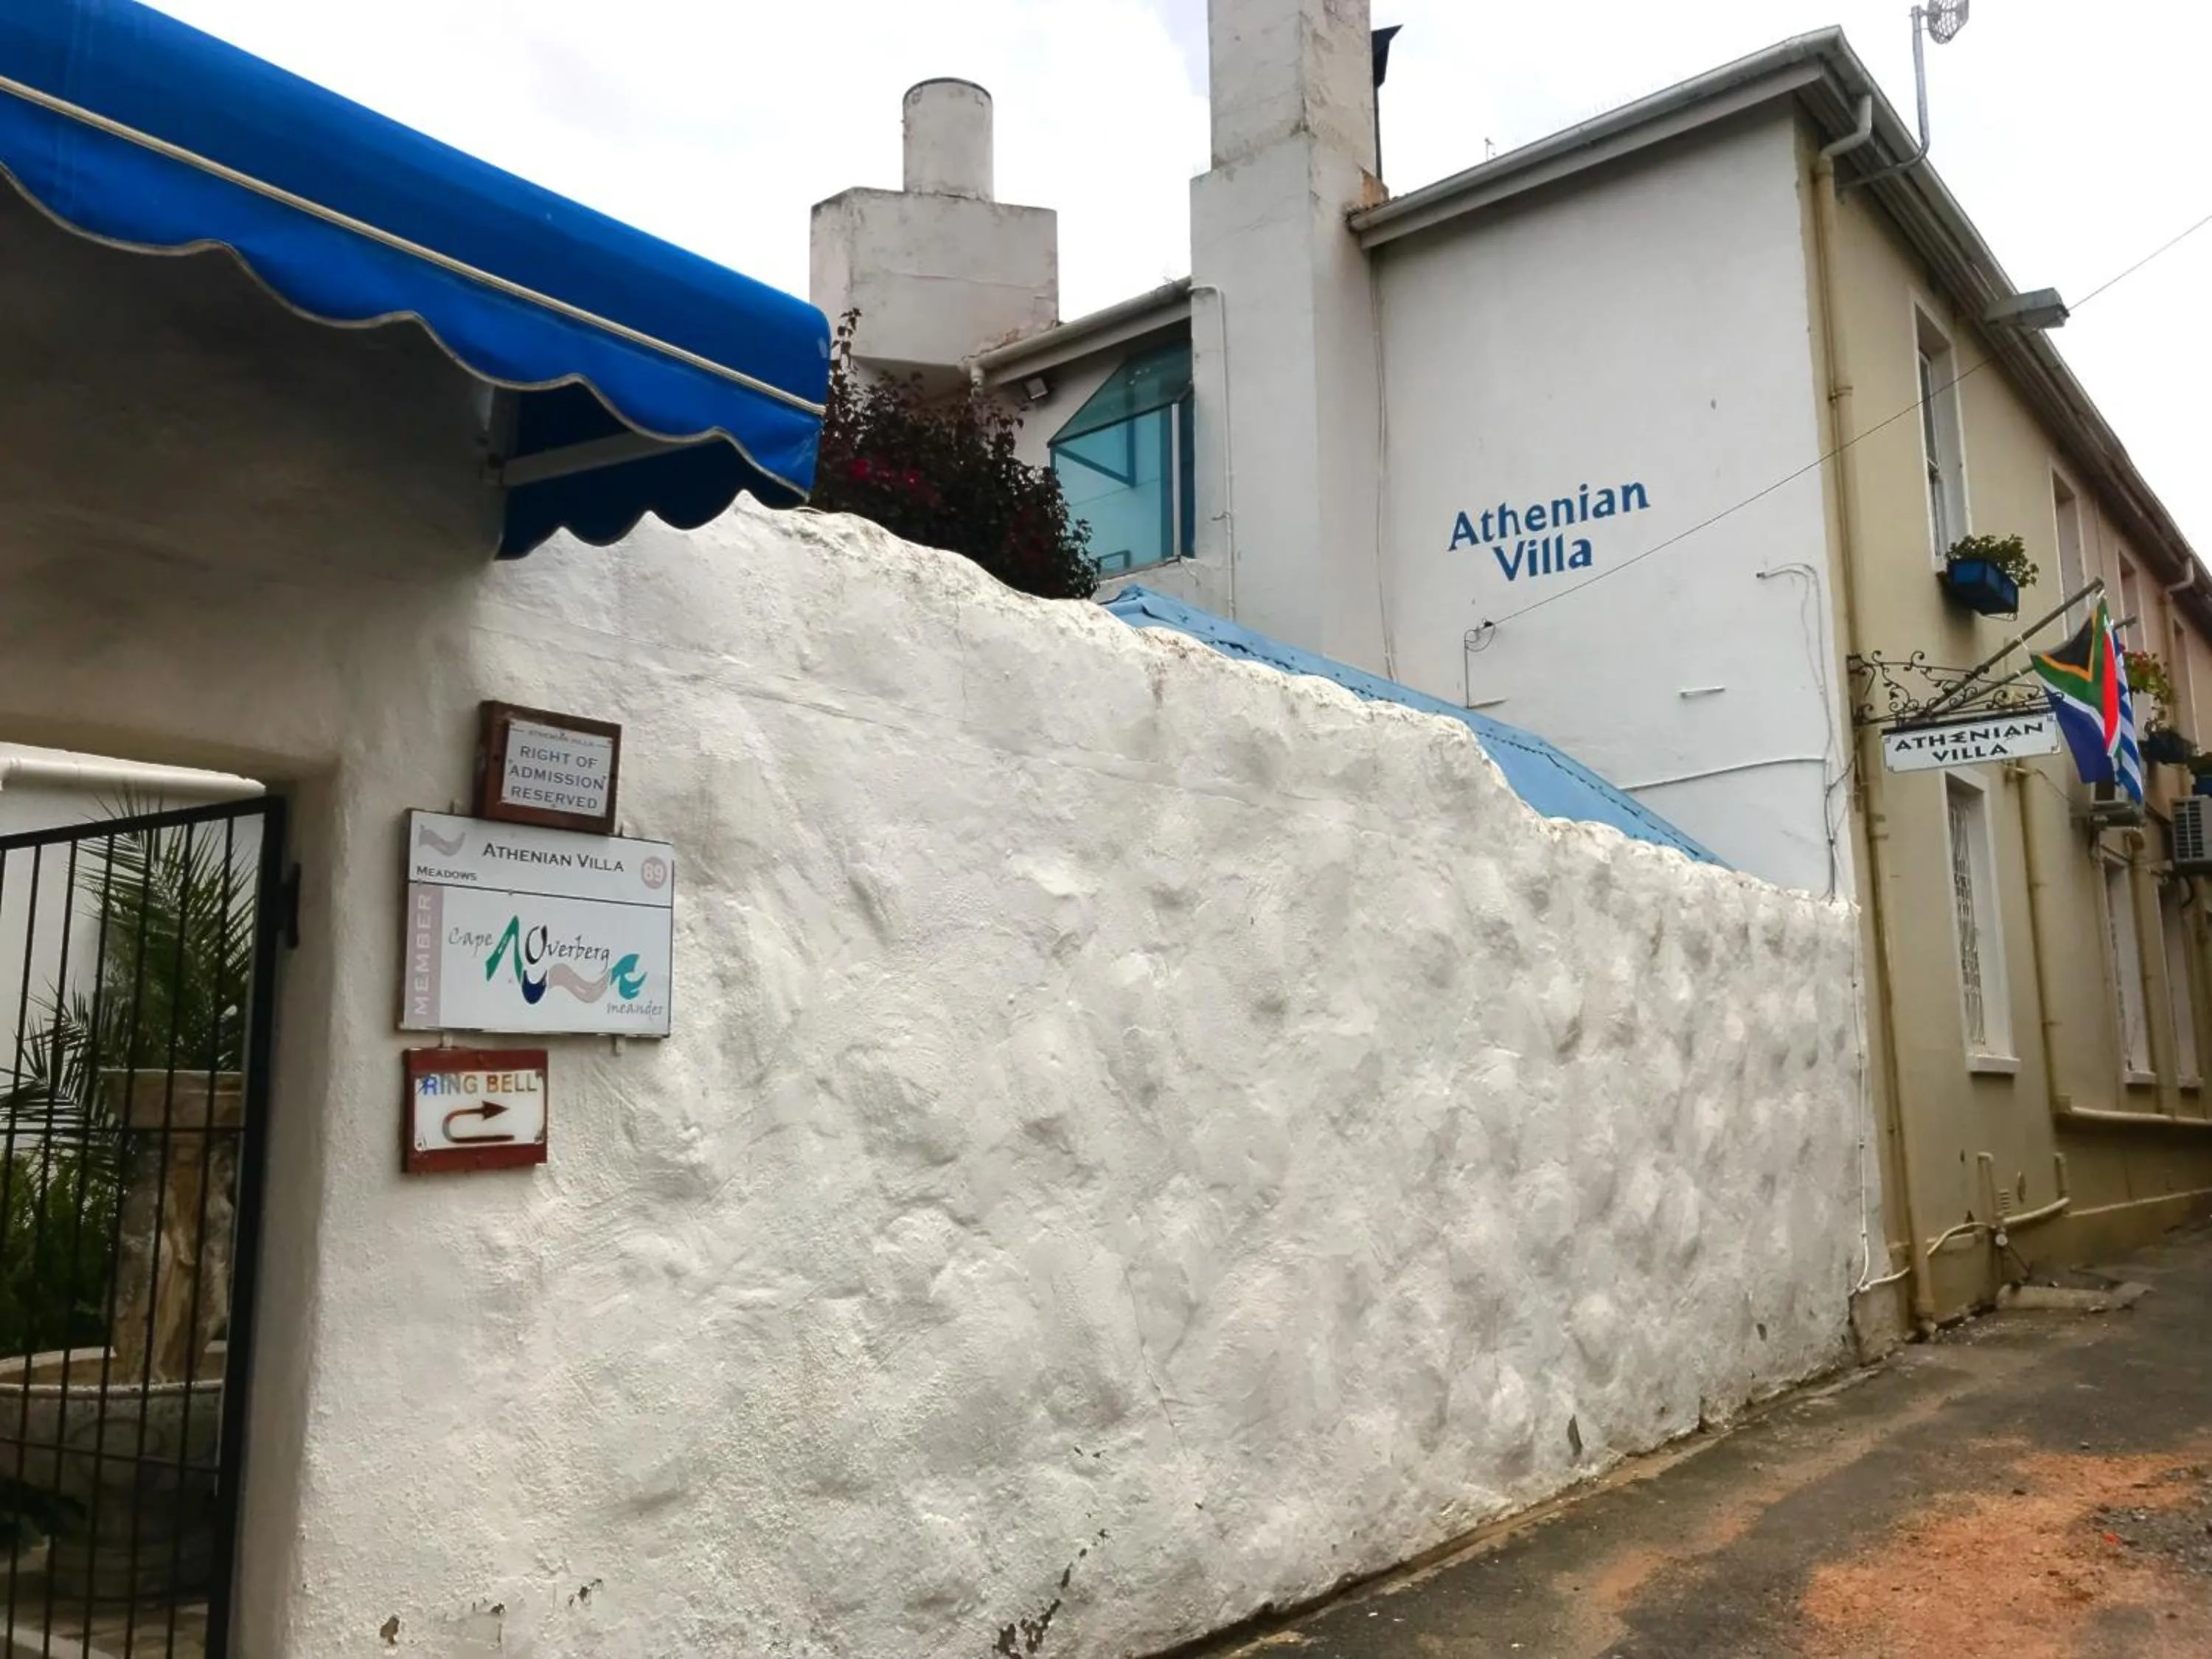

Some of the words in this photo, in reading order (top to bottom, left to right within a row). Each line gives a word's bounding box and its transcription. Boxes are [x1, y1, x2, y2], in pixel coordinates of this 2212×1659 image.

[1447, 481, 1651, 552] Athenian
[1492, 533, 1593, 582] Villa
[520, 745, 571, 765] RIGHT
[576, 756, 598, 769] OF
[1932, 743, 2008, 762] VILLA
[509, 765, 604, 790] ADMISSION
[511, 786, 597, 809] RESERVED
[482, 842, 572, 867] ATHENIAN
[577, 853, 625, 872] VILLA
[417, 866, 477, 881] MEADOWS
[644, 862, 664, 883] 89
[448, 927, 493, 956] Cape
[414, 894, 432, 1015] MEMBER
[423, 1074, 478, 1096] RING
[487, 1074, 537, 1093] BELL
